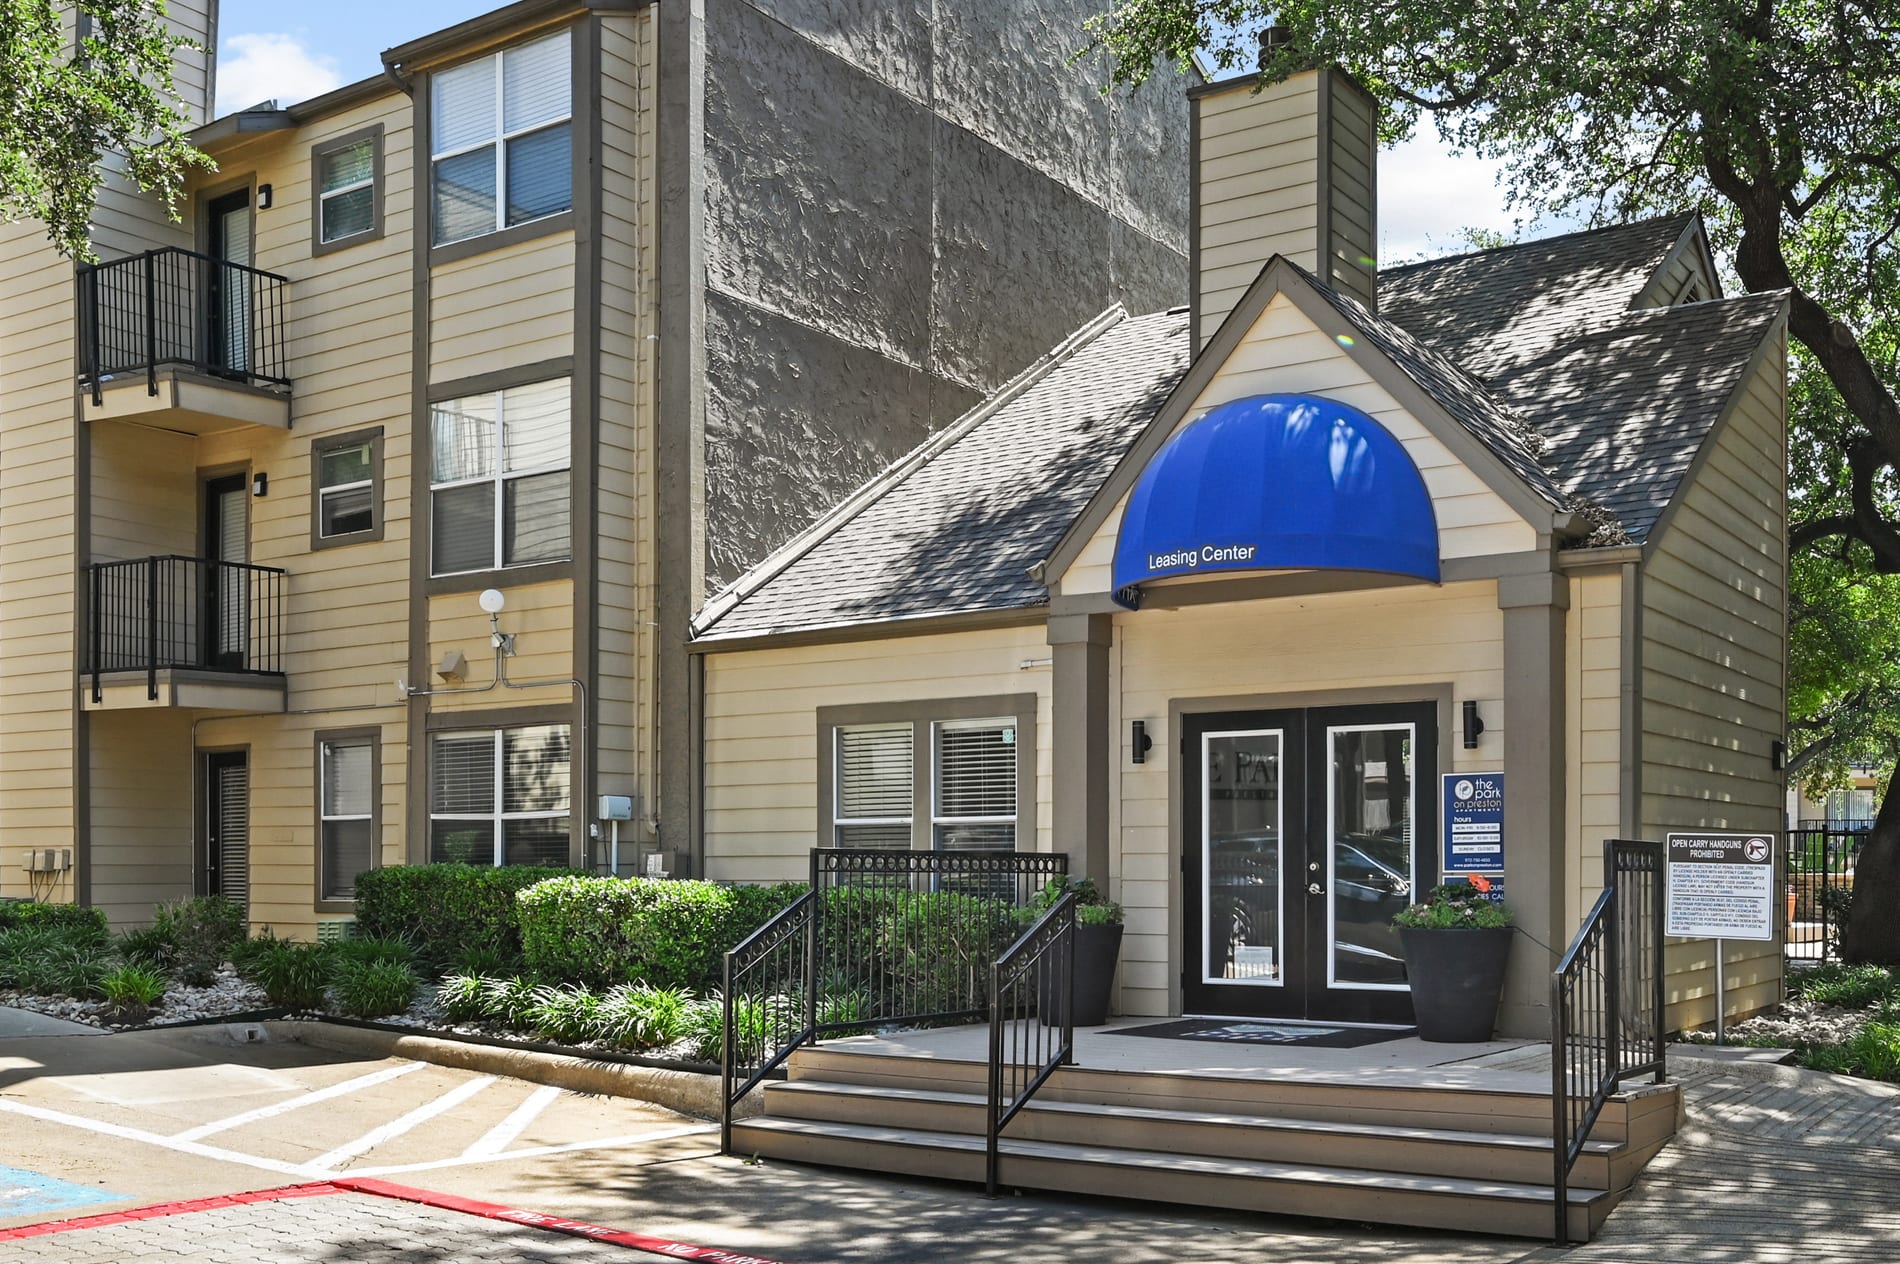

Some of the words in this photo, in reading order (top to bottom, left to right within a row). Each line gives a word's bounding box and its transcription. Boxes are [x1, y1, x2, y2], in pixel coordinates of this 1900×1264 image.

[1149, 550, 1197, 569] Leasing
[1202, 545, 1254, 562] Center
[1235, 752, 1279, 783] PA
[1475, 778, 1493, 790] the
[1475, 788, 1501, 800] park
[1467, 800, 1502, 809] preston
[1672, 839, 1688, 848] OPEN
[1689, 839, 1709, 848] CARRY
[1709, 840, 1742, 848] HANDGUNS
[1690, 850, 1724, 858] PROHIBITED
[496, 1210, 557, 1222] FIRE
[552, 1222, 620, 1234] LANE
[656, 1244, 699, 1254] NO
